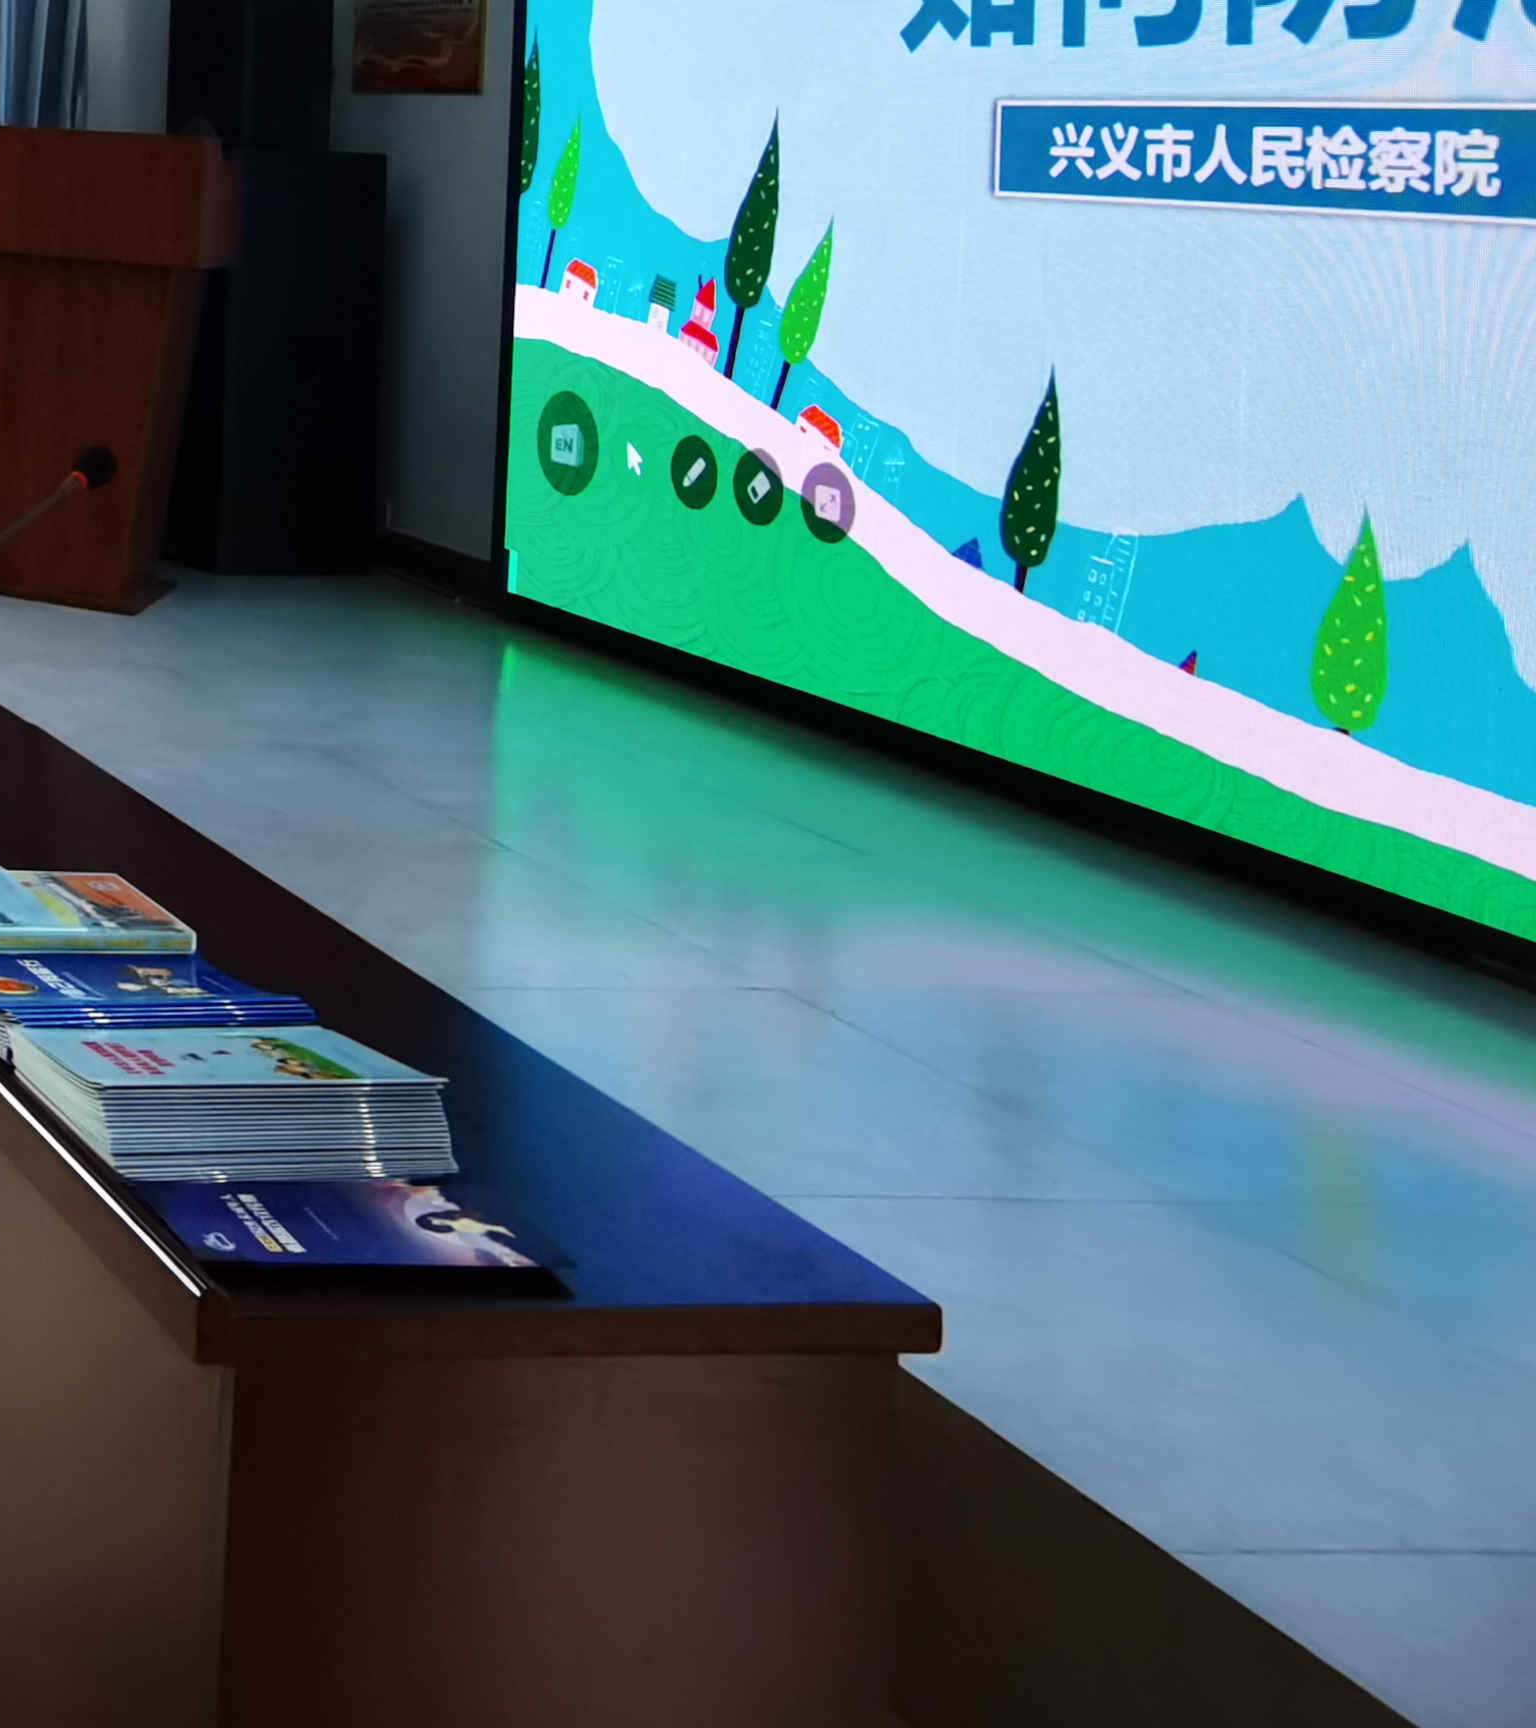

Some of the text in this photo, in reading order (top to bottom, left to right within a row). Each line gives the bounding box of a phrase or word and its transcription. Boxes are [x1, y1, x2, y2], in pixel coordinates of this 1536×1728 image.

[1048, 121, 1502, 198] 兴义市人民检察院
[555, 438, 574, 453] EN
